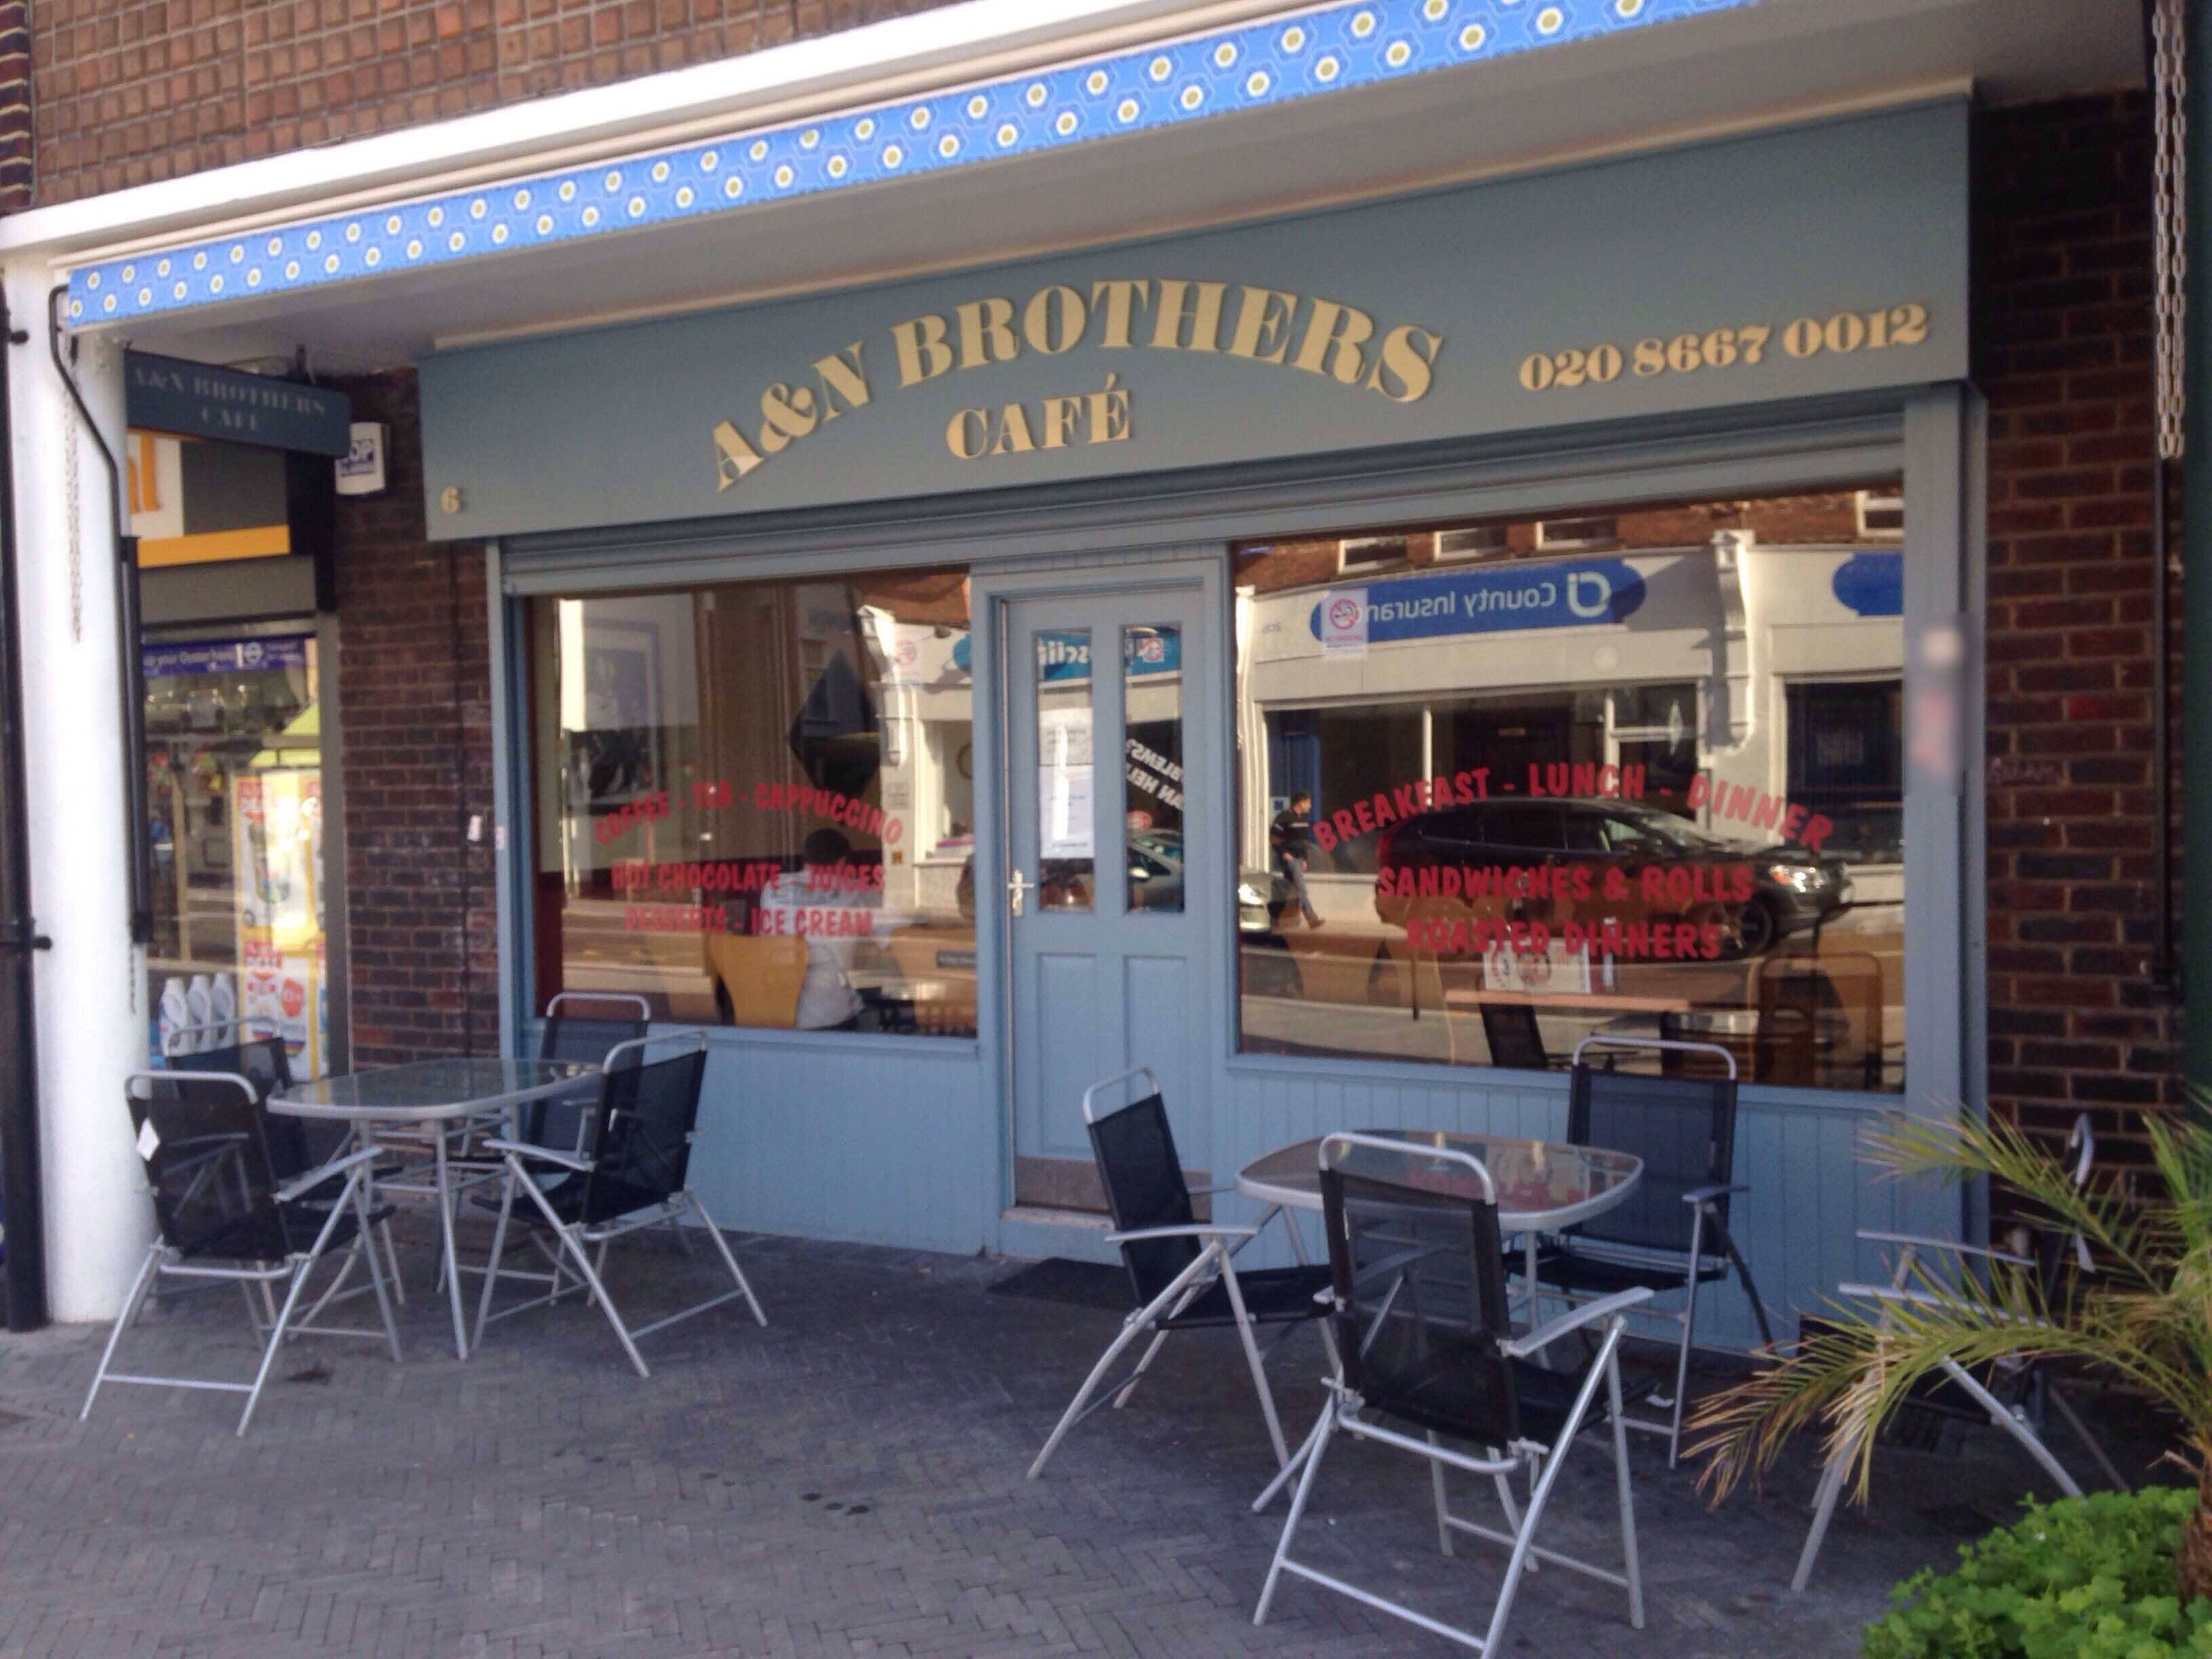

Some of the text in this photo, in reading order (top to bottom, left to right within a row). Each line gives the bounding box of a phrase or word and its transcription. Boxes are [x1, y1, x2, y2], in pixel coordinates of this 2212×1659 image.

[1519, 304, 1929, 390] 020 8667 0012
[712, 279, 1443, 491] A&N BROTHERS
[945, 372, 1130, 459] CAFÉ
[441, 485, 460, 514] 6
[594, 790, 670, 845] COFFEE
[754, 781, 903, 844] CAPPUCCINO
[1313, 766, 1490, 852] BREAKFAST
[1529, 761, 1645, 799] LUNCH
[1686, 774, 1833, 853] DINNER
[611, 863, 650, 890] HOT
[658, 862, 781, 890] CHOCOLATE
[806, 863, 884, 893] JUICES
[1378, 865, 1753, 903] SANDWICHES & ROLLS
[750, 907, 785, 937] ICE
[794, 907, 874, 937] CREAM
[1406, 916, 1722, 960] ROASTED DINNERS
